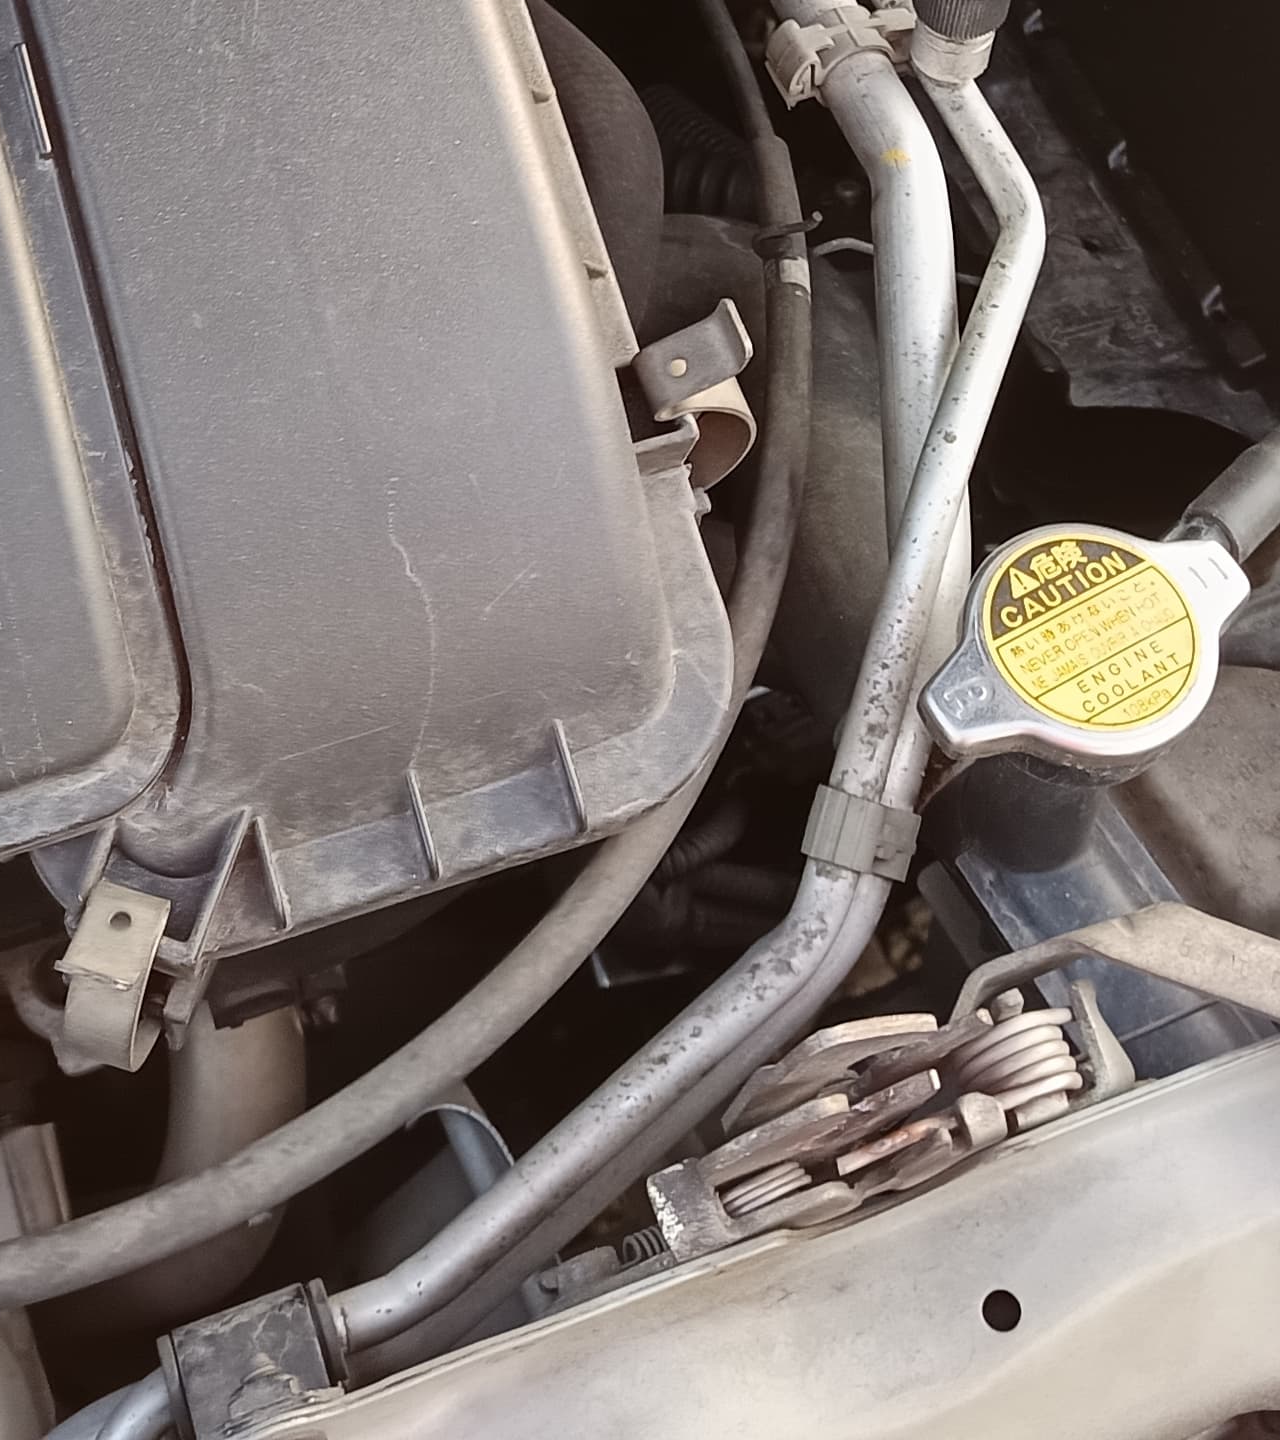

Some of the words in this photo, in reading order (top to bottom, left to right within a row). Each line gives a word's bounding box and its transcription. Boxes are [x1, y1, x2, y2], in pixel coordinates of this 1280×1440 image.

[1000, 552, 1127, 628] CAUTION
[1019, 642, 1065, 677] NEVER
[1063, 623, 1101, 653] OPEN
[1099, 605, 1136, 633] WHEN
[1077, 640, 1165, 694] ENGINE
[1082, 652, 1181, 713] COOLANT
